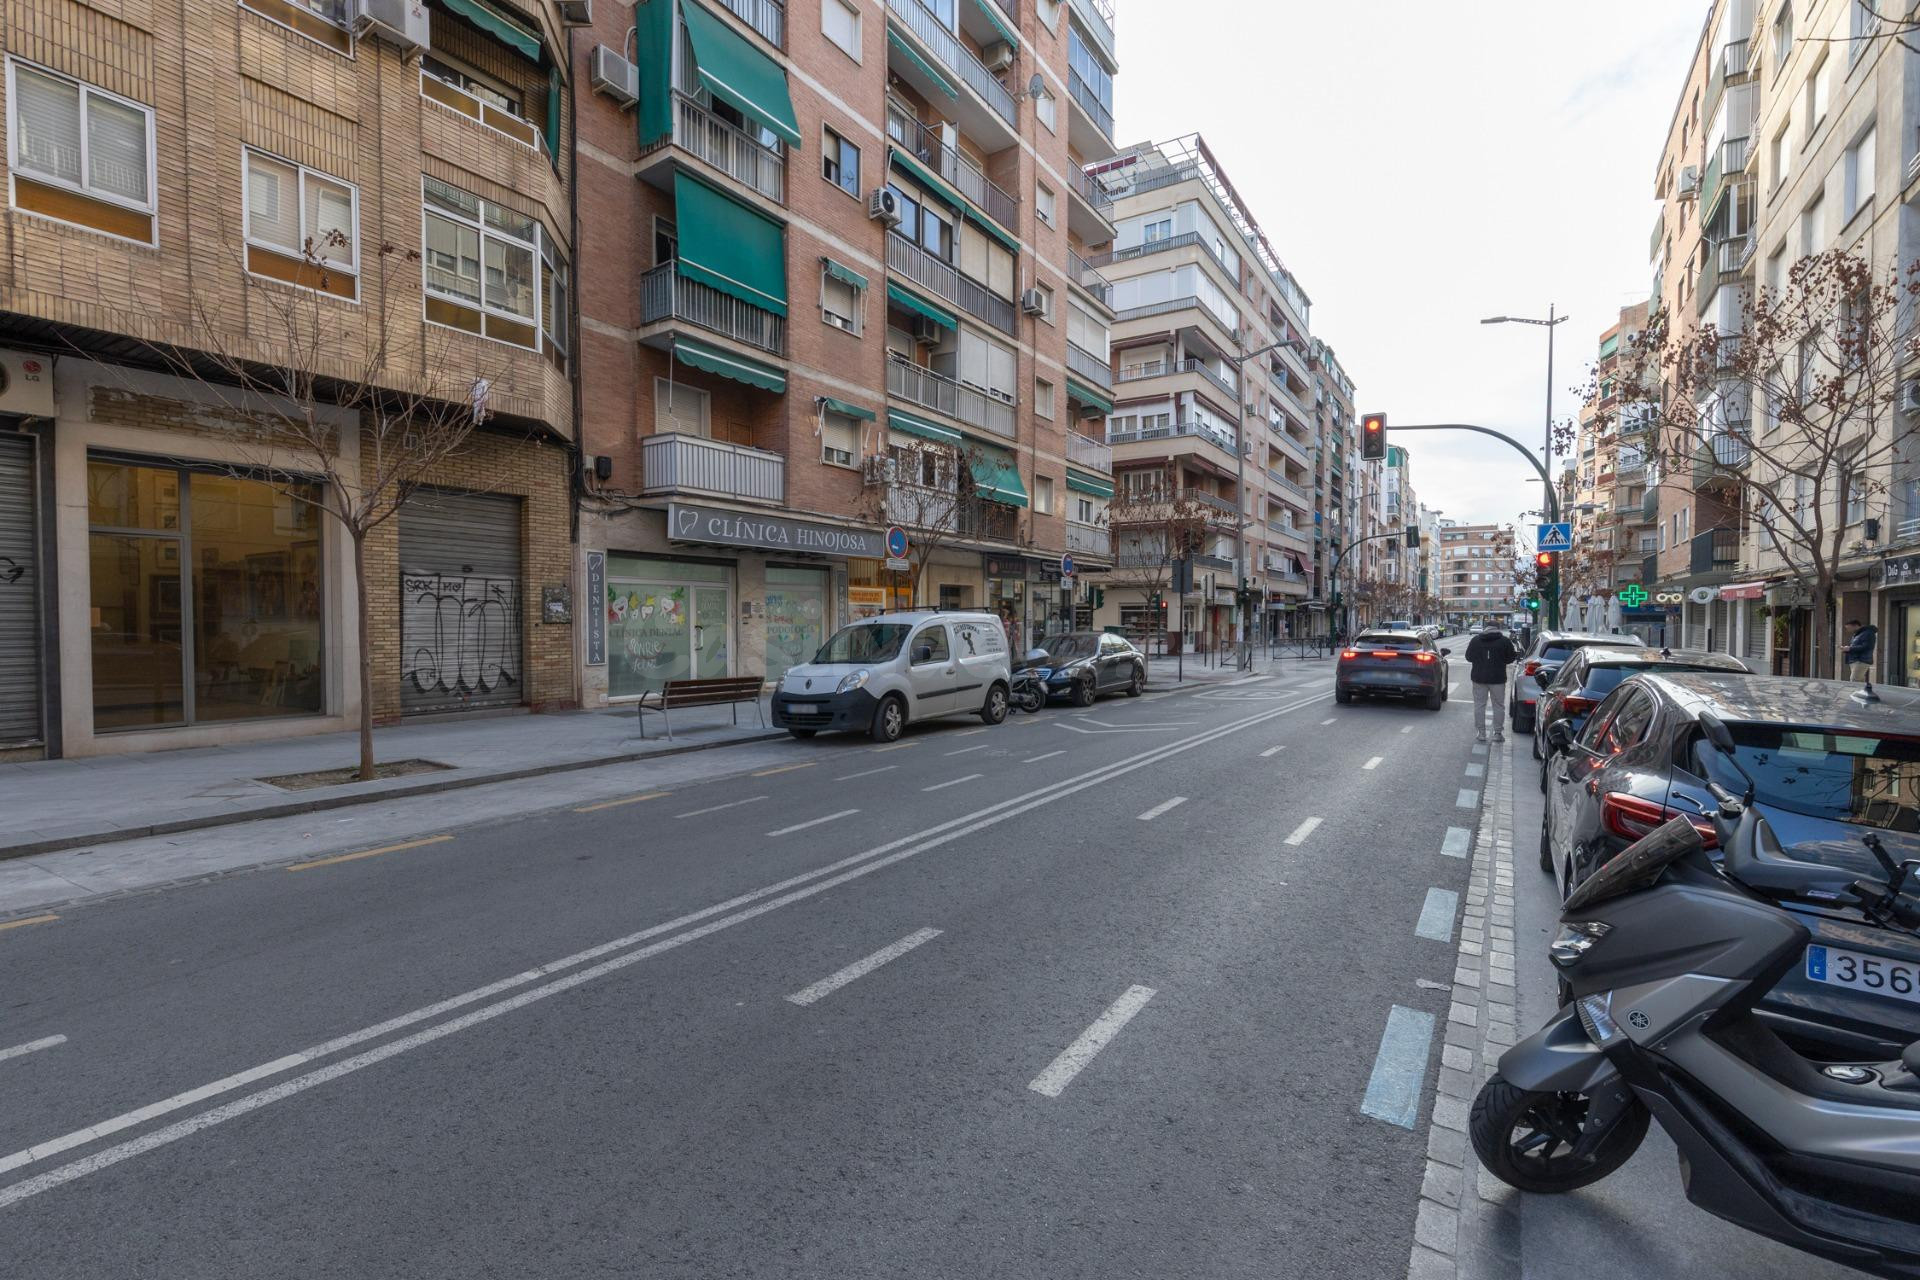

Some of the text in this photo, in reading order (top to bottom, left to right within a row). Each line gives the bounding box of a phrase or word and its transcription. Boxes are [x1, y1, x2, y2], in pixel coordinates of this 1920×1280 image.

[25, 374, 40, 382] LG
[707, 516, 867, 552] CLÍNICA HINOJOSA
[591, 573, 601, 662] DENTISTA
[1814, 966, 1821, 974] E
[1836, 955, 1920, 997] 356
